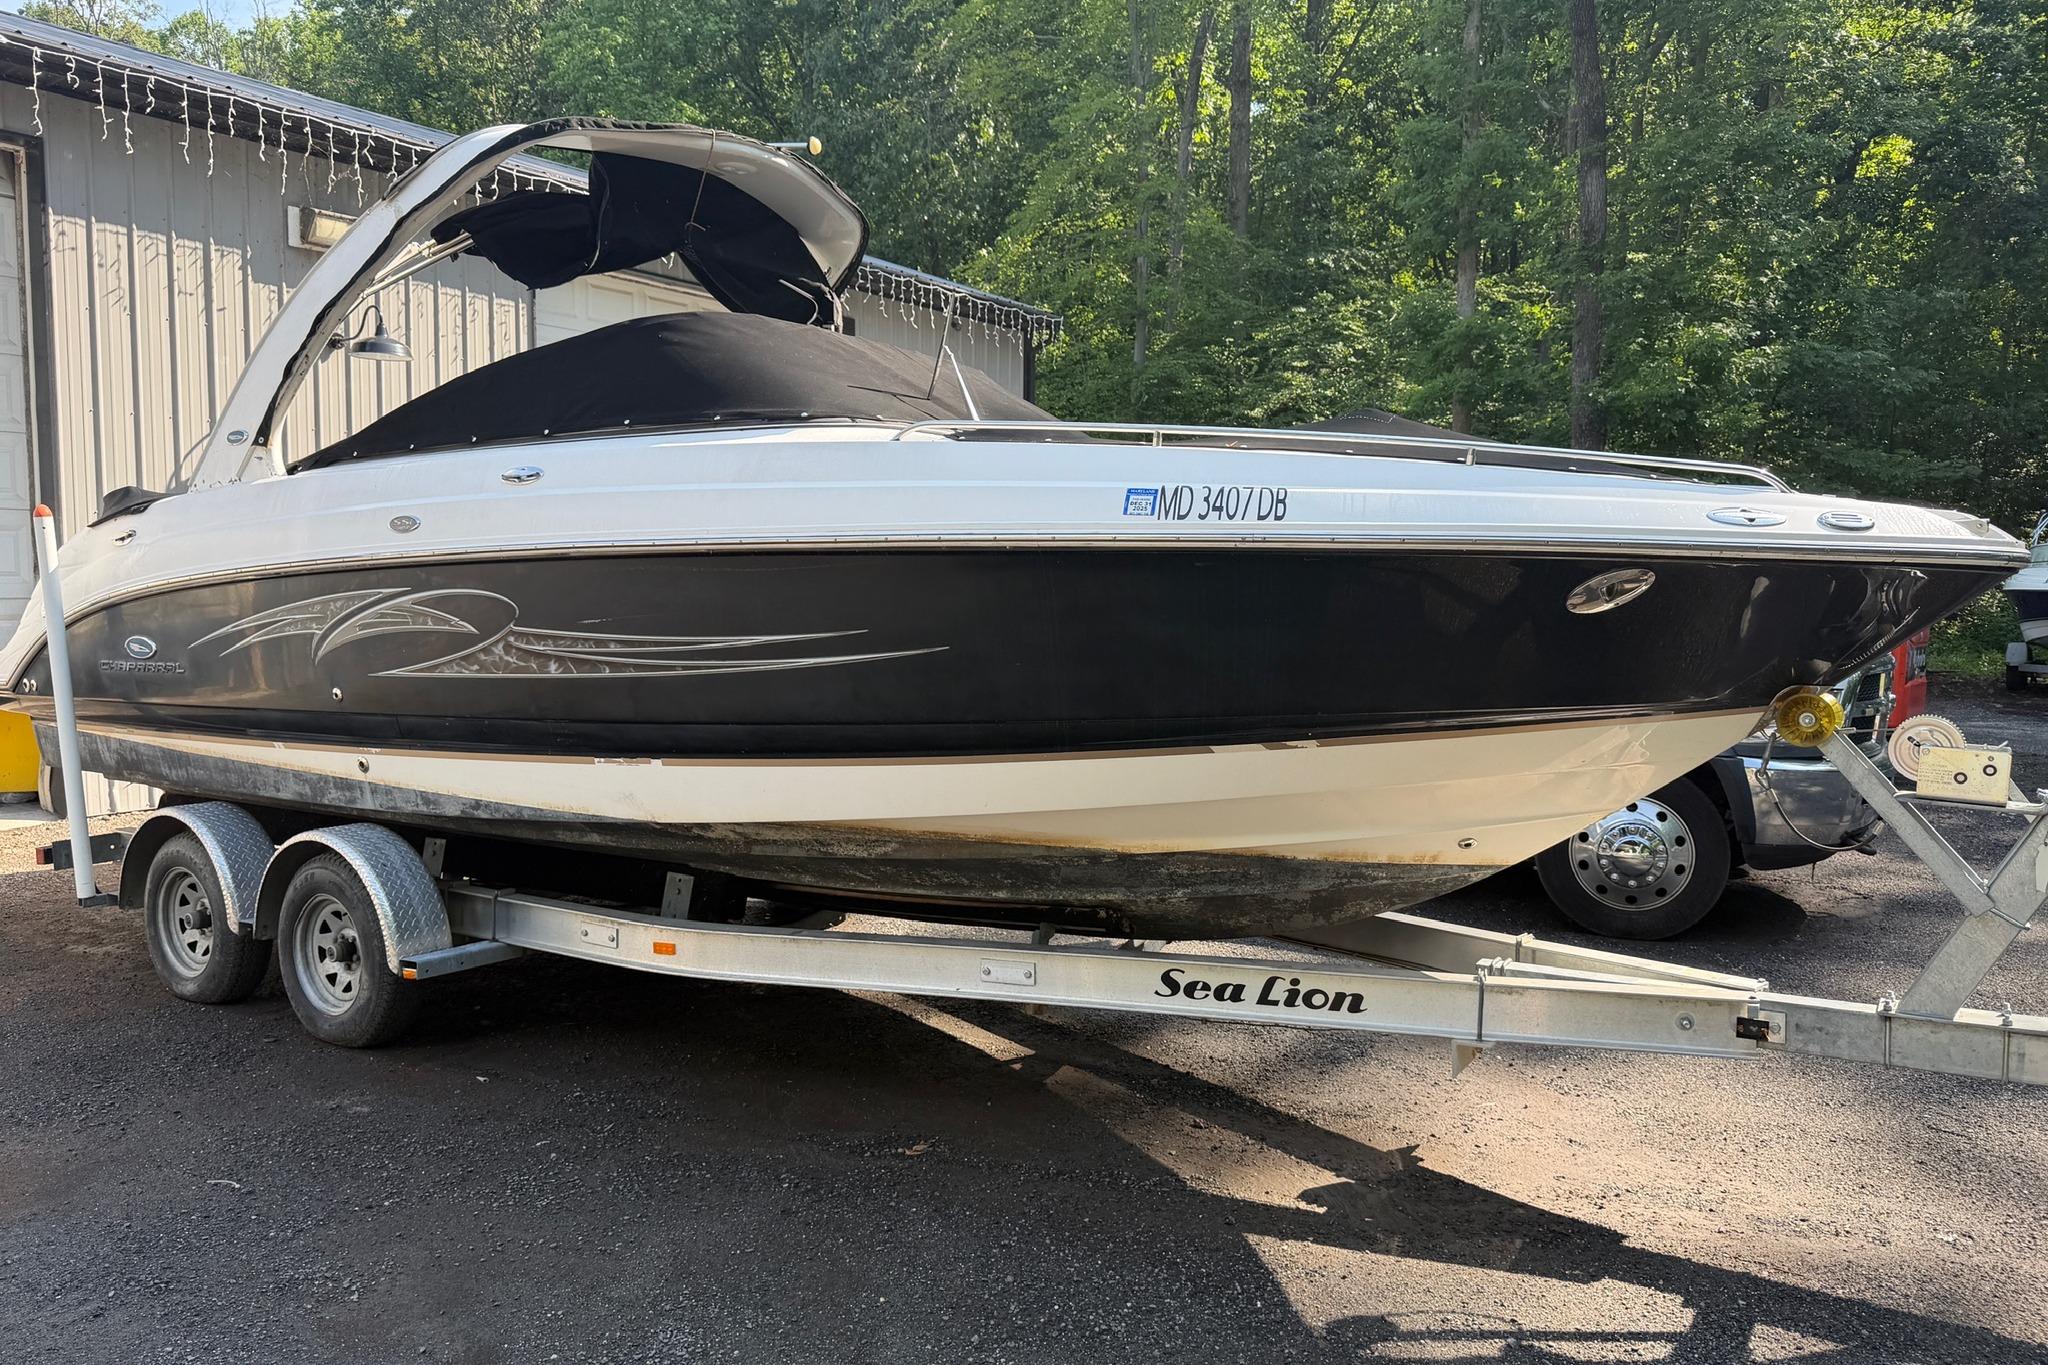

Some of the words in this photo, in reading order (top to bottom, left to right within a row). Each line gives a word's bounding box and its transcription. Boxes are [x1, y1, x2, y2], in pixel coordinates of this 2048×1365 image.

[1157, 485, 1194, 521] MD
[100, 660, 186, 674] CHAPARRAL
[1154, 968, 1247, 1003] Sea
[1255, 976, 1368, 1013] Lion
